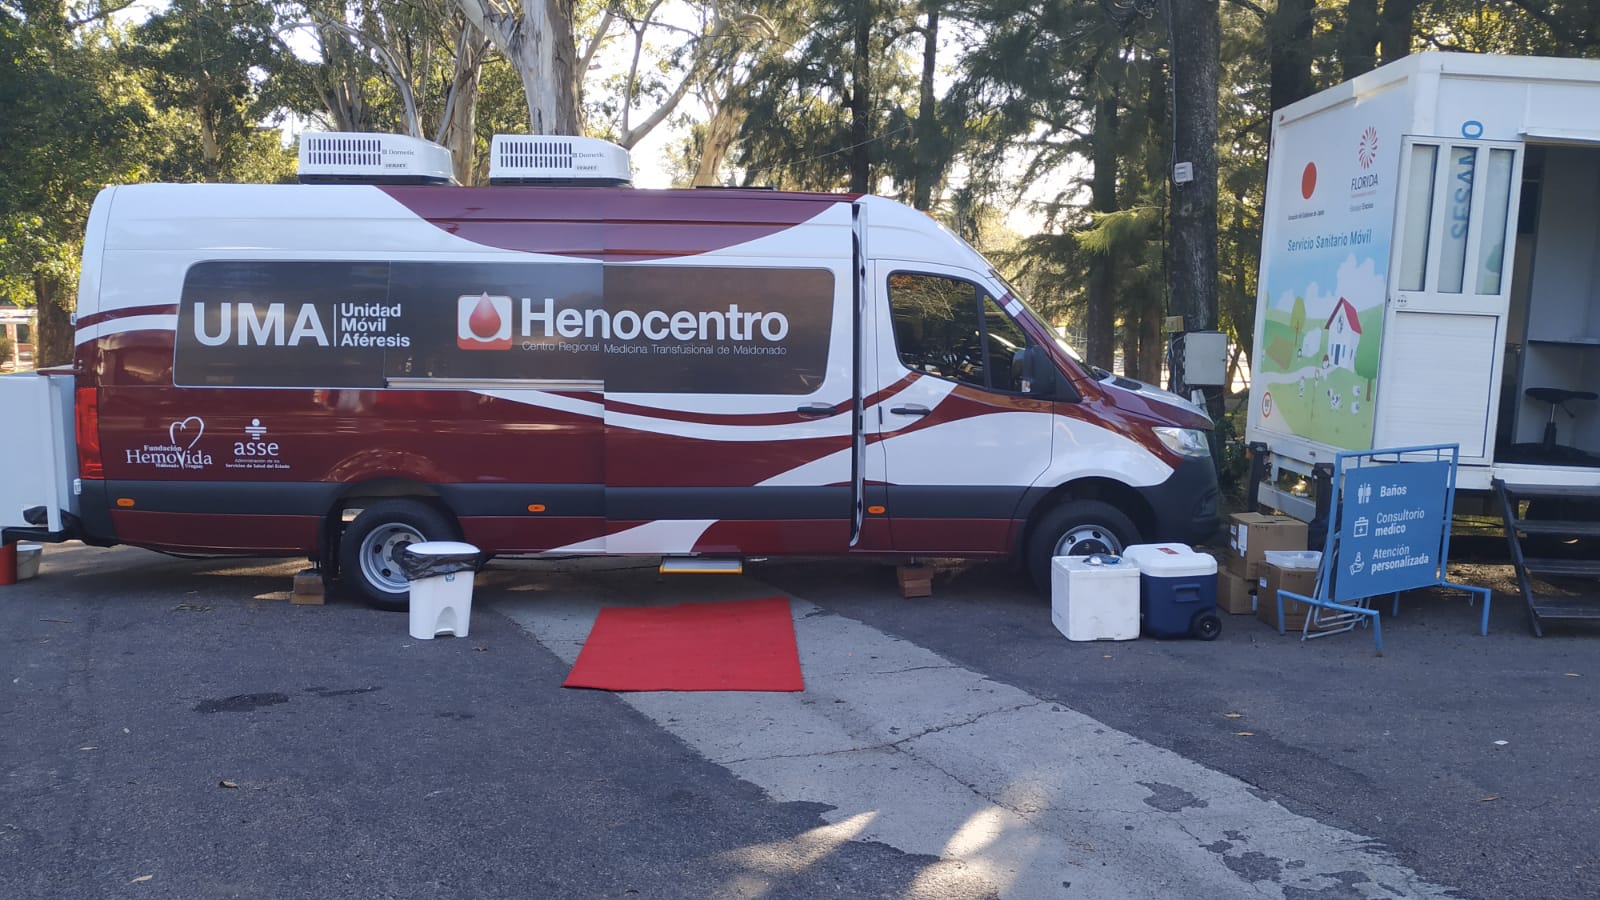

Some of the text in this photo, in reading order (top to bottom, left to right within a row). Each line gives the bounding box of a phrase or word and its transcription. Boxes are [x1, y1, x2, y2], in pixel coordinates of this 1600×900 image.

[1351, 173, 1379, 191] FLORIDA
[1287, 228, 1372, 252] Servicio Sanitario Móvil
[341, 303, 401, 317] Unidad
[193, 302, 329, 347] UMA
[341, 317, 386, 332] Móvil
[521, 297, 789, 342] Henocentro
[341, 332, 410, 347] Aféresis
[522, 341, 786, 355] Centro Regional Medicina Transfusional de Maldonado
[143, 444, 182, 452] Fundación
[234, 442, 279, 456] asse
[126, 449, 213, 469] HemoVida
[1380, 484, 1407, 498] Baños
[1376, 507, 1425, 524] Consultorio
[1372, 543, 1410, 560] Atención
[1371, 553, 1429, 576] personalizada
